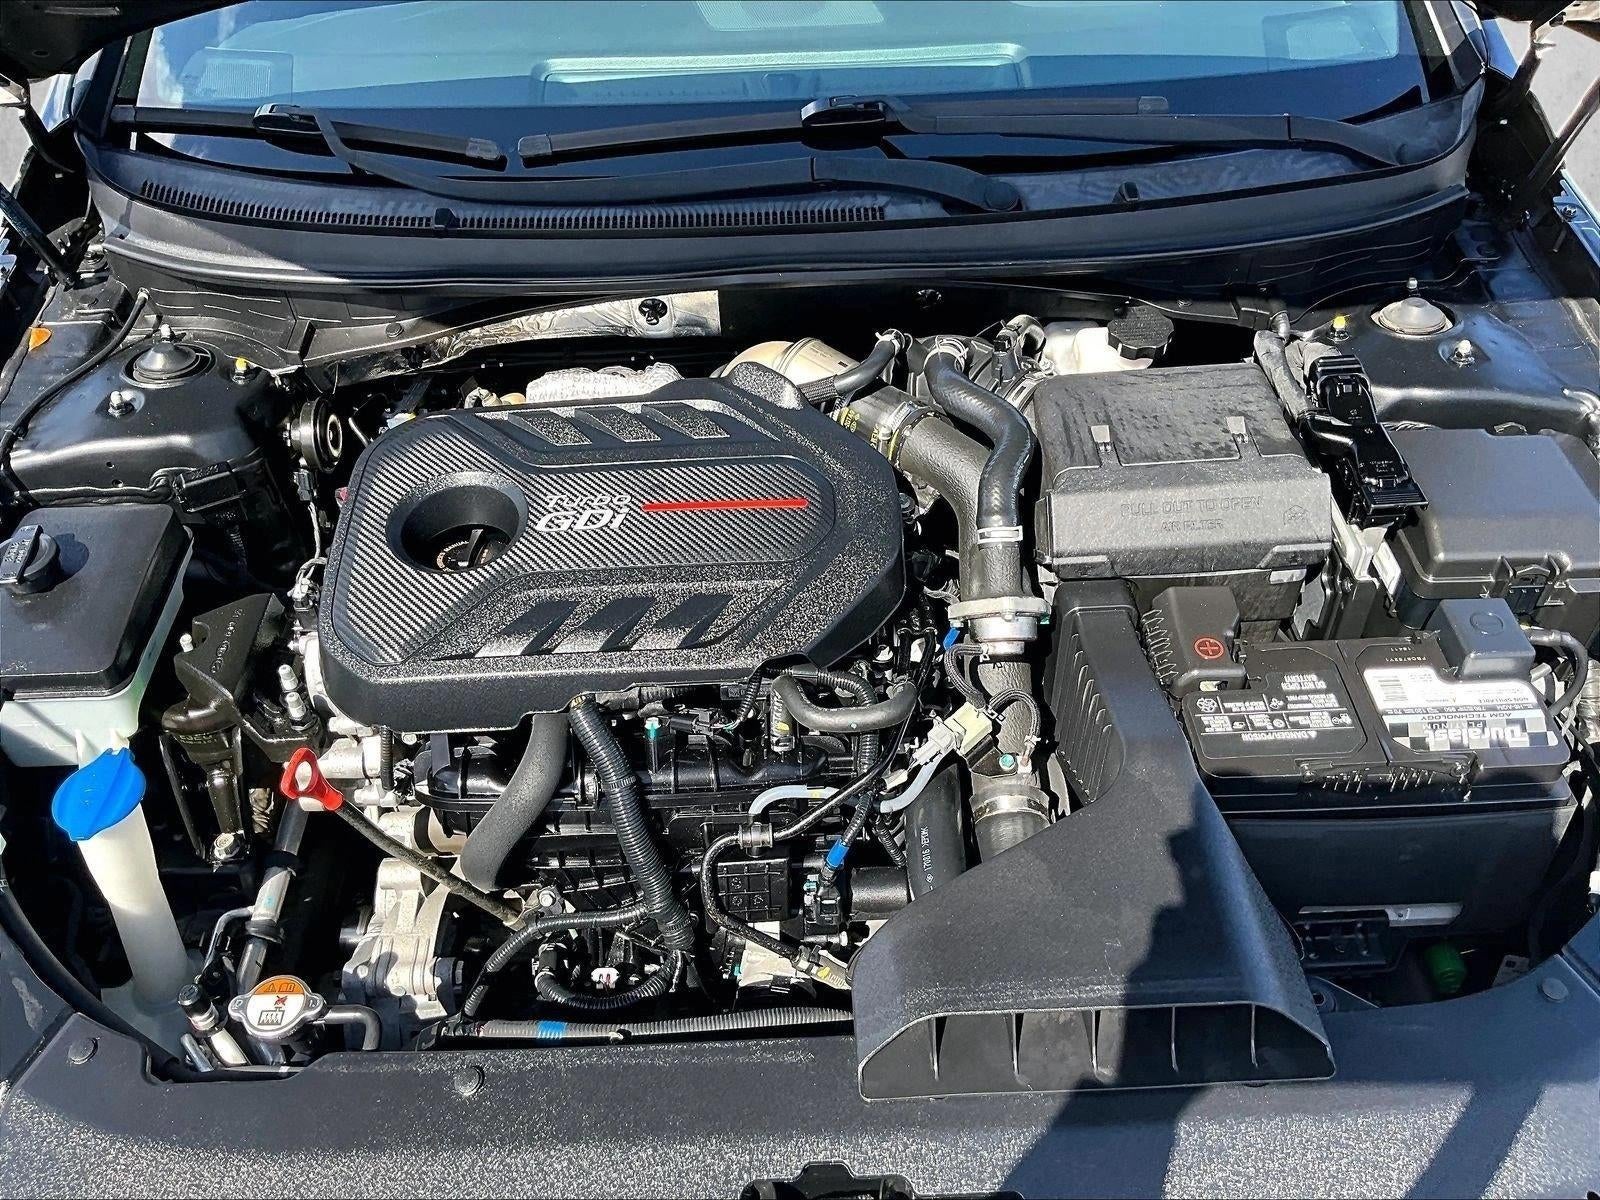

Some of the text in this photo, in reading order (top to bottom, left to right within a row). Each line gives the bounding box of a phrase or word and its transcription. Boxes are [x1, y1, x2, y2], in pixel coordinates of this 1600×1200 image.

[1119, 495, 1263, 518] PULL OUT TO OPEN
[535, 507, 630, 532] GDi
[1301, 681, 1316, 690] NOT
[1420, 713, 1487, 721] TECHNOLOGY
[1422, 721, 1484, 730] PLATINUM
[1423, 727, 1529, 746] Duralast
